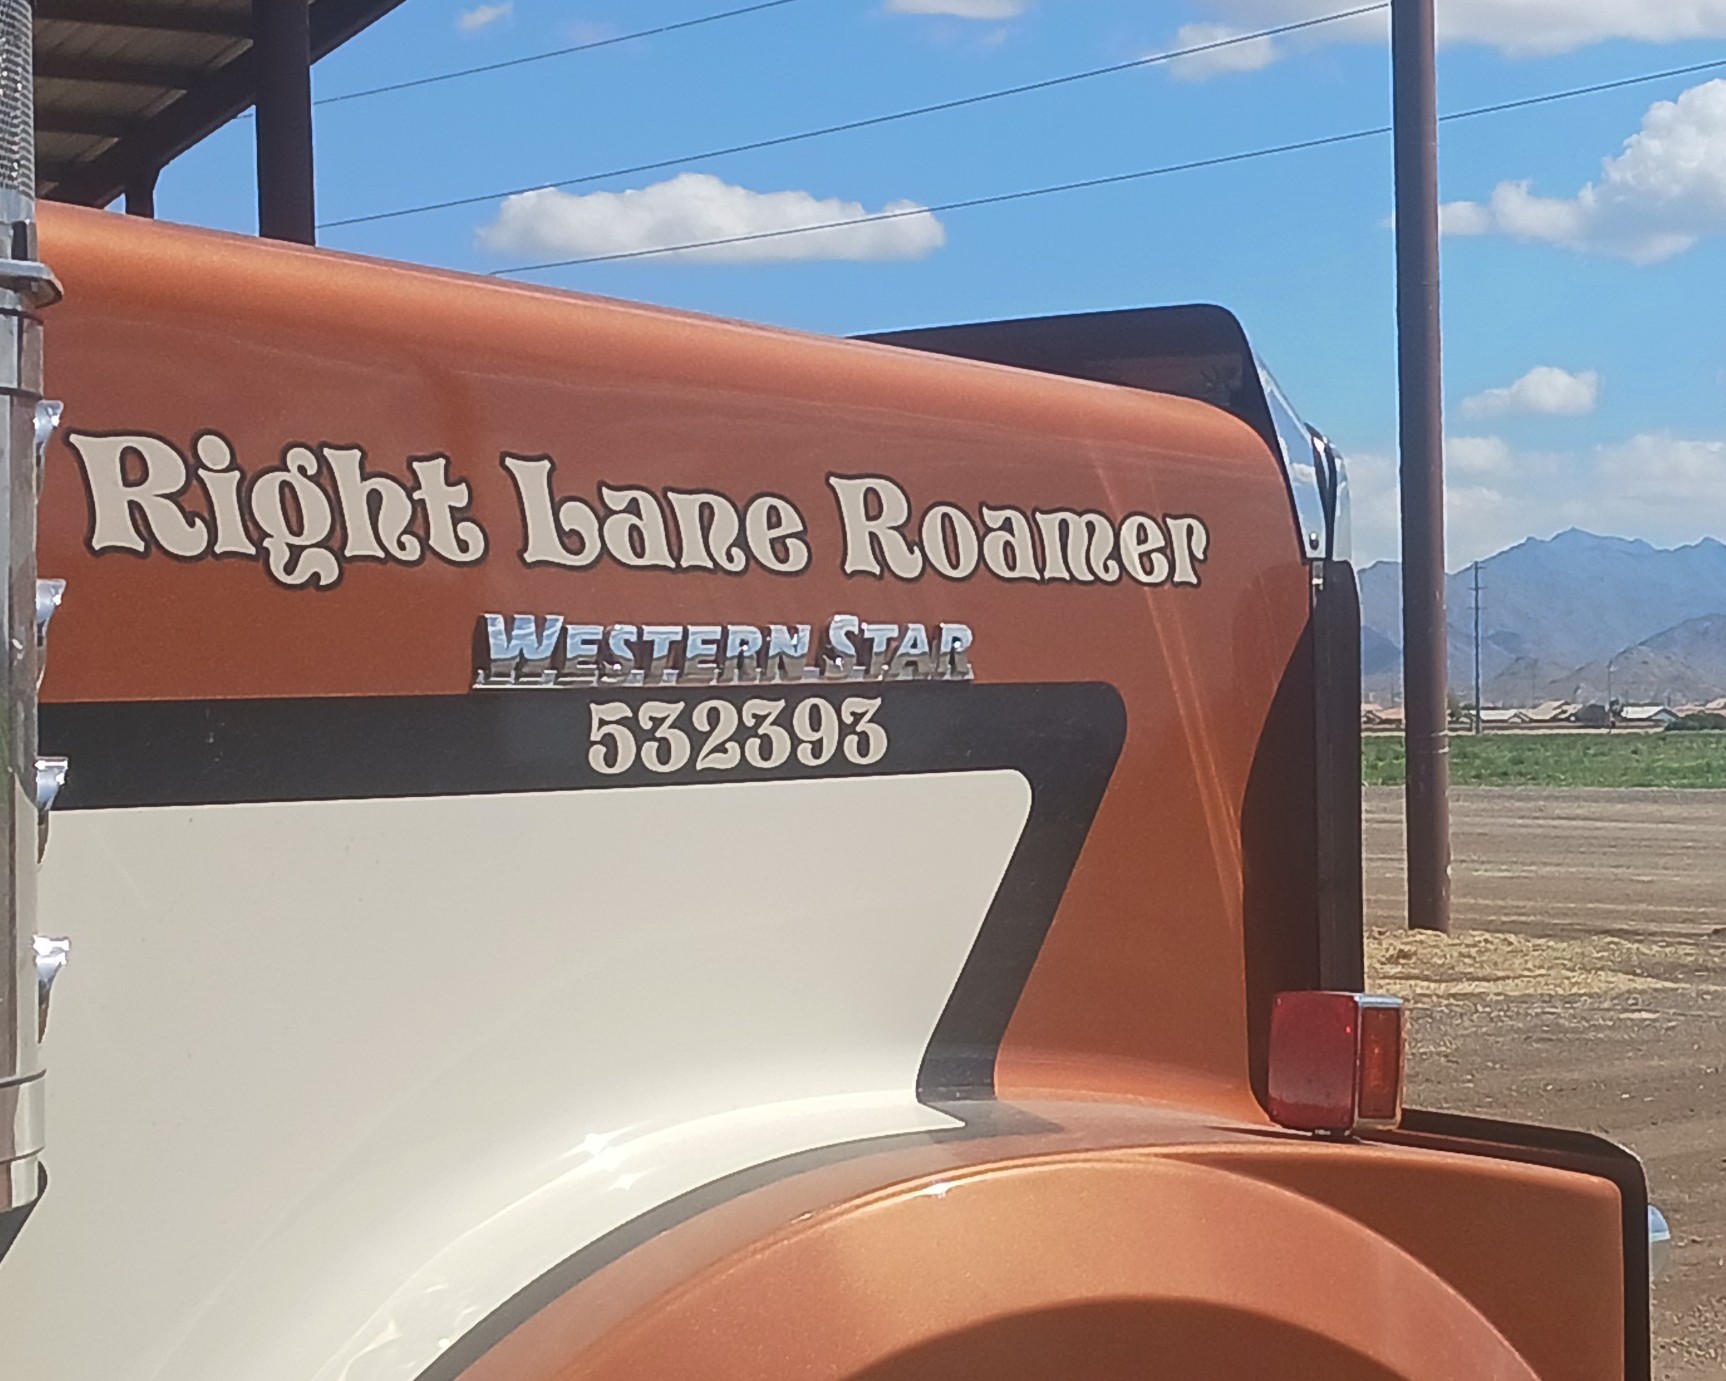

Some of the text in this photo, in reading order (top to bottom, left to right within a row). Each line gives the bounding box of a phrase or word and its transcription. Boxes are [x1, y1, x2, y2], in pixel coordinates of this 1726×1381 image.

[68, 431, 1209, 588] Right Lane Roamer
[474, 612, 975, 689] WESTERN STAR
[587, 696, 889, 777] 532393
